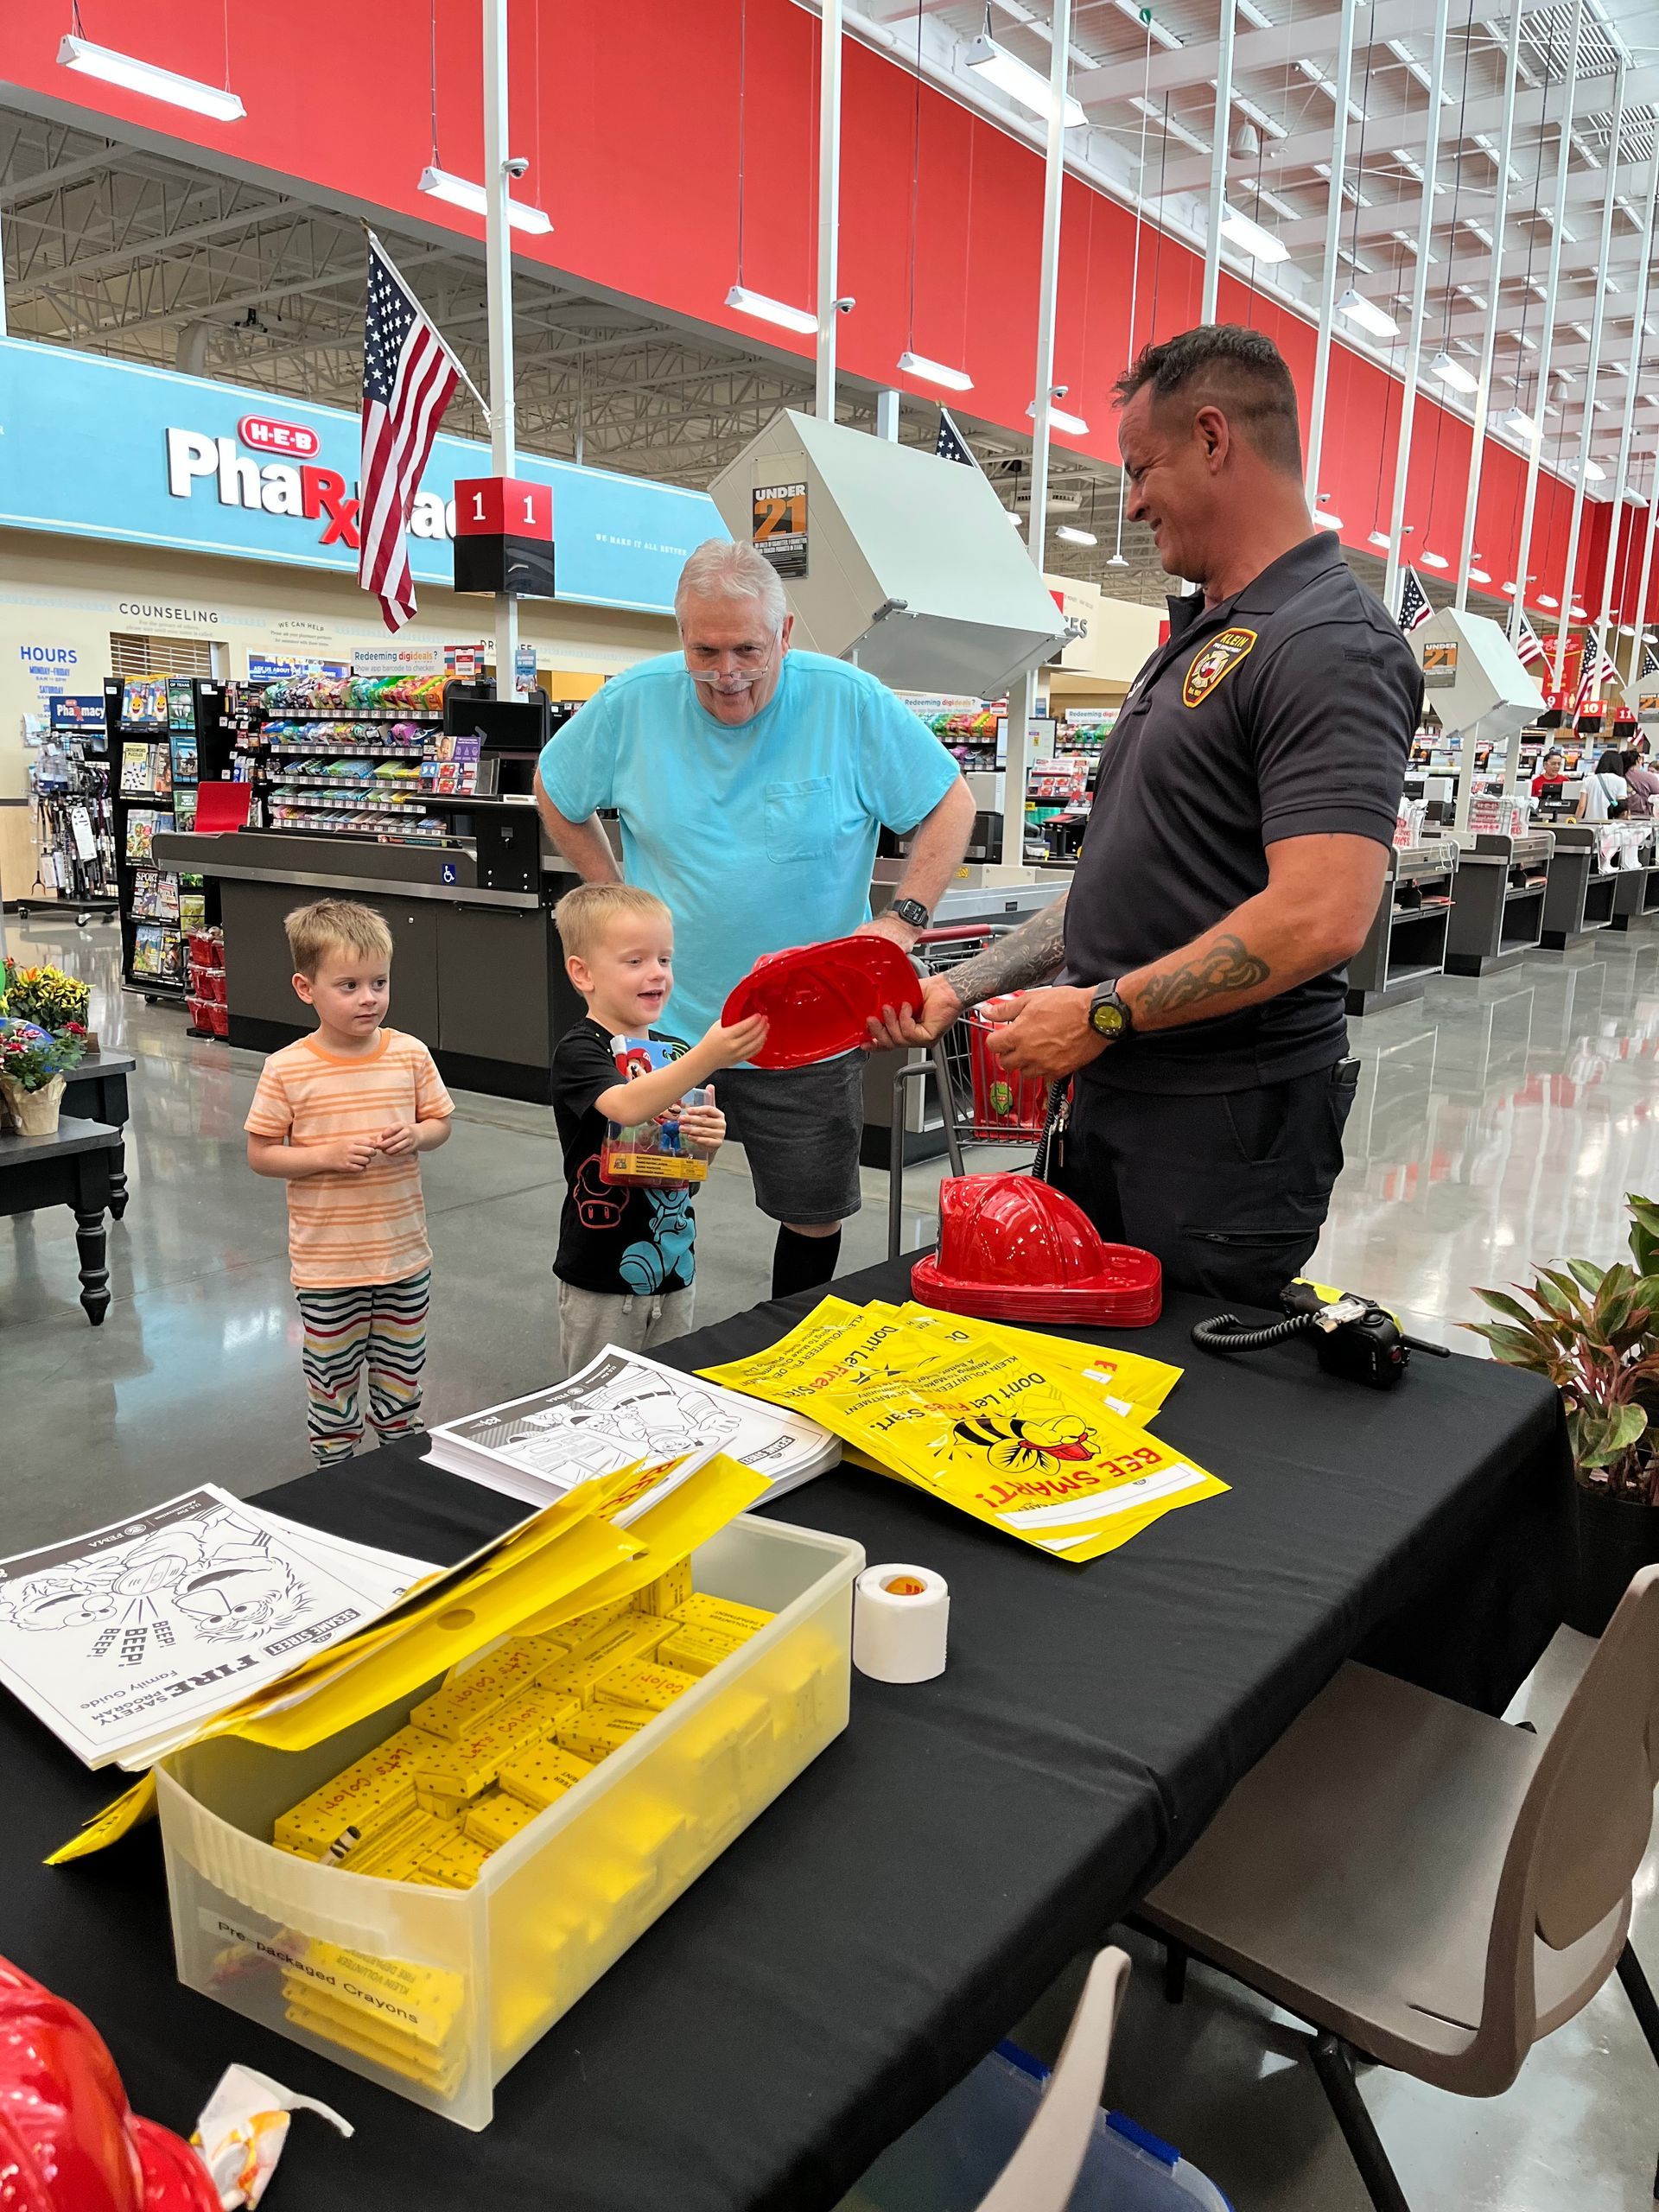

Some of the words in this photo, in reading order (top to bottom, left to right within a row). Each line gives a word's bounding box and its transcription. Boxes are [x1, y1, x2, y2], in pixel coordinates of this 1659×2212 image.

[754, 485, 806, 501] UNDER
[472, 491, 486, 521] 1
[523, 494, 536, 524] 1
[753, 496, 807, 540] 21
[595, 533, 606, 543] WE
[609, 535, 632, 547] MAKE
[633, 538, 641, 549] IT
[644, 540, 658, 552] ALL
[660, 544, 688, 556] BETTER
[119, 603, 219, 624] COUNSELING
[307, 622, 324, 632] HELP
[1220, 633, 1249, 648] KLEIN
[20, 645, 77, 664] HOURS
[354, 651, 397, 663] Redeeming
[1423, 648, 1458, 671] 21
[371, 665, 382, 674] app
[1547, 695, 1556, 709] 9
[1583, 703, 1599, 714] 10
[803, 1328, 845, 1360] VOLUNTEER
[861, 1325, 899, 1353] Don't
[959, 1359, 991, 1374] Helping
[994, 1355, 1019, 1371] KLEIN
[809, 1363, 849, 1389] Fires
[925, 1376, 948, 1389] Make
[935, 1369, 993, 1394] VOLUNTEER
[1004, 1372, 1046, 1399] Don't
[545, 1392, 570, 1403] FEMA
[843, 1389, 911, 1416] DEPARTMENT
[923, 1402, 971, 1413] Fires
[969, 1394, 1001, 1409] Let
[869, 1408, 925, 1431] Start.
[766, 1435, 795, 1456] SESAME
[1097, 1447, 1163, 1478] BEE
[975, 1470, 1101, 1509] SMART!
[154, 1499, 197, 1521] Administration
[88, 1533, 125, 1548] FEMA
[152, 1619, 177, 1649] BEEP!
[312, 1609, 359, 1636] SESAME
[86, 1628, 122, 1658] BEEP!
[118, 1627, 148, 1668] BEEP!
[268, 1631, 313, 1656] STREET
[498, 1651, 530, 1675] Let's
[129, 1669, 178, 1692] Family
[163, 1654, 260, 1699] FIRE
[630, 1672, 684, 1695] Color!
[79, 1689, 127, 1710] Guide
[448, 1675, 495, 1708] Color!
[91, 1690, 162, 1721] PROGRAM
[99, 1694, 168, 1726] SAFETY
[459, 1735, 495, 1760] Let's
[499, 1701, 543, 1733] Color!
[375, 1748, 413, 1776] Let's
[315, 1777, 372, 1816] Color!
[217, 1920, 336, 1986] Pre-packaged
[343, 1983, 419, 2025] Crayons
[336, 1955, 384, 1985] VOLUNTEER
[385, 1980, 410, 1997] KLEIN
